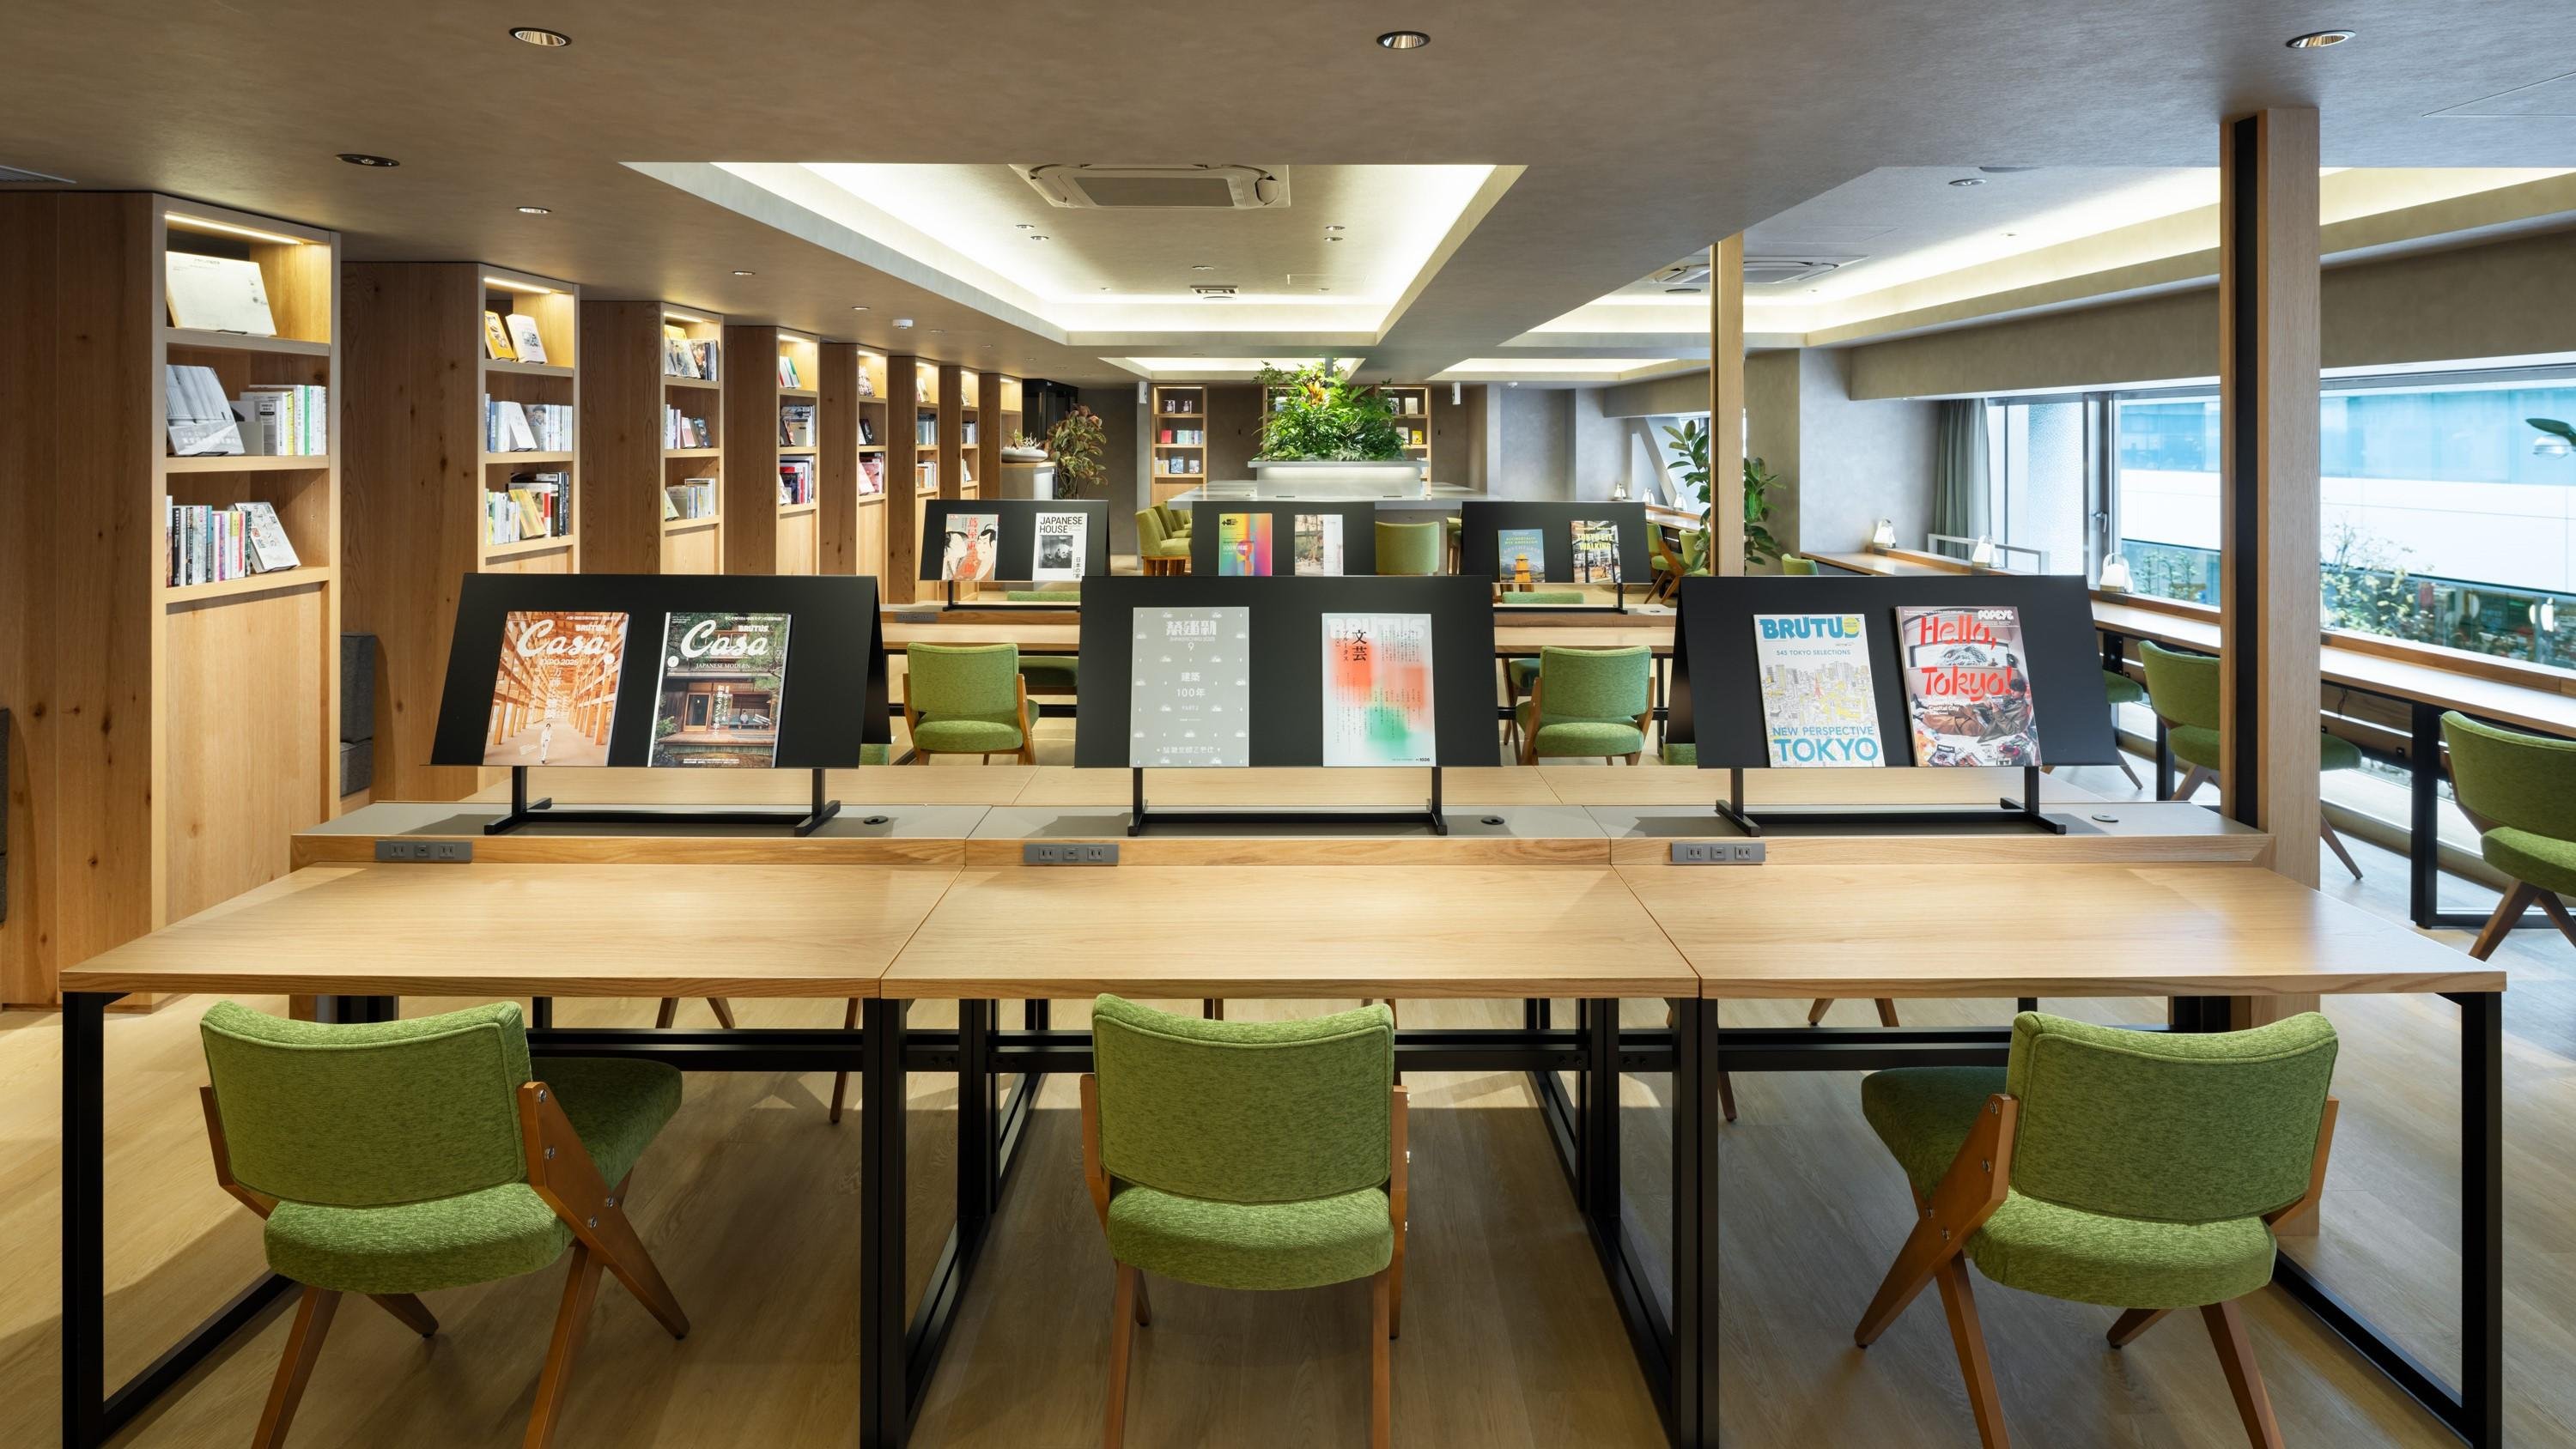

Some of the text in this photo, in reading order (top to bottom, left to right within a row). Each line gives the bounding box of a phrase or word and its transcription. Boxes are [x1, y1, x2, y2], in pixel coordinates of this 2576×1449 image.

[1040, 516, 1083, 524] JAPANESE
[1039, 524, 1068, 533] HOUSE
[1978, 609, 2014, 620] POPEYE
[1919, 615, 1998, 650] Hello,
[517, 619, 606, 658] Casa
[680, 619, 769, 658] Casa
[1188, 642, 1194, 652] 9
[1352, 629, 1367, 662] 文芸
[1181, 672, 1200, 682] 建築
[1921, 665, 2013, 702] Tokyo!
[1176, 688, 1206, 698] 100年
[1772, 726, 1874, 736] NEW PERSPECTIVE
[1773, 737, 1878, 762] TOKYO
